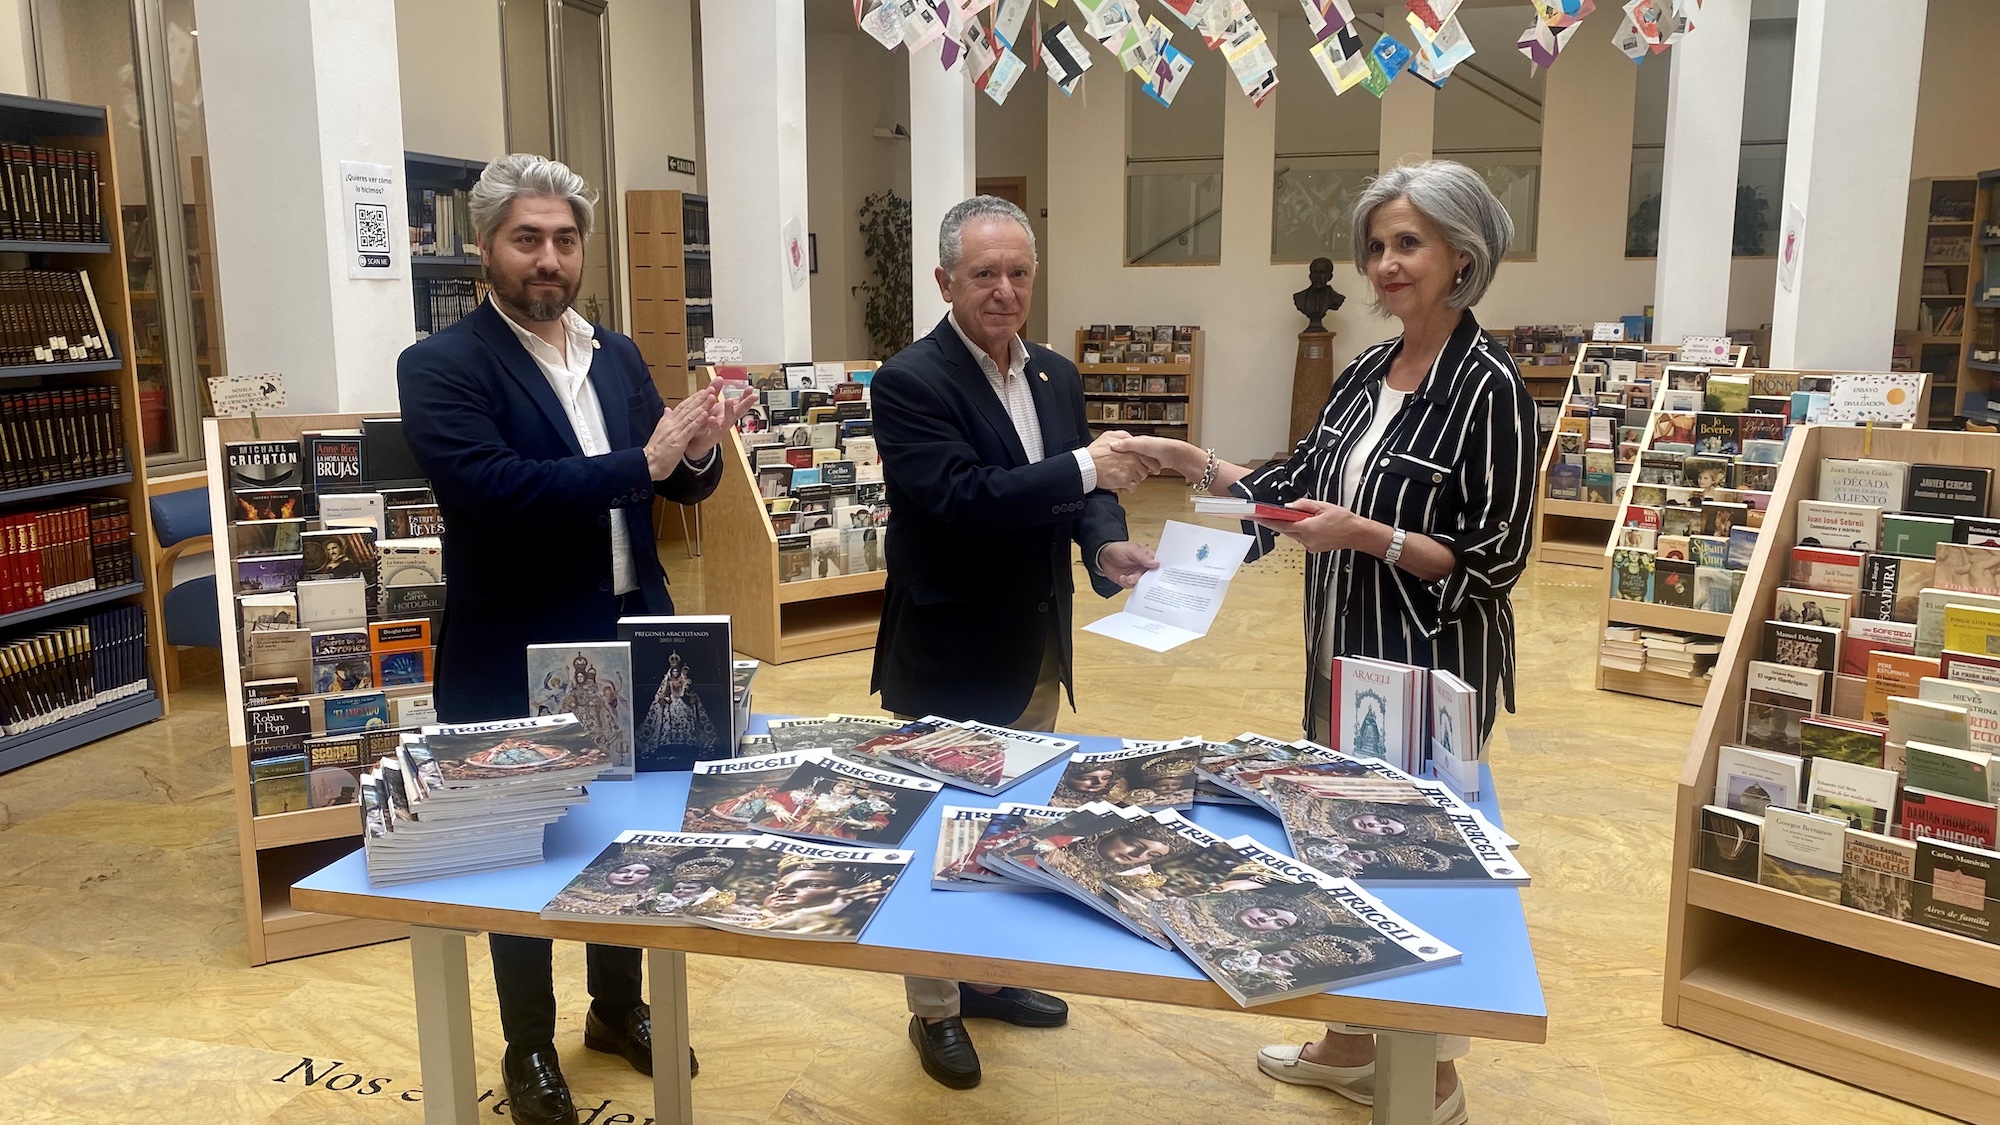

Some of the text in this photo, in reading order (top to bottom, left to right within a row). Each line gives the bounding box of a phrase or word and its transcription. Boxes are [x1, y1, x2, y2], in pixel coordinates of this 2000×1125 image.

[1758, 379, 1793, 391] MONK
[1713, 417, 1720, 426] Jo
[1700, 425, 1734, 436] Beverley
[239, 444, 286, 453] MICHAEL
[316, 444, 357, 455] Anne Rice
[230, 453, 297, 466] CRICHTON
[317, 462, 359, 478] BRUJAS
[1872, 468, 1893, 477] Galán
[1843, 476, 1890, 489] DÉCADA
[1920, 478, 1973, 491] JAVIER CERCAS
[1834, 493, 1887, 505] ALIENTO
[1807, 515, 1864, 527] Juan José Sebreli
[410, 523, 446, 536] REYES
[1968, 526, 1997, 535] Remedios
[1692, 539, 1723, 554] Susan
[1700, 553, 1723, 566] King
[1879, 564, 1896, 621] SCADURA
[1776, 630, 1822, 644] Manuel Delgado
[1352, 669, 1390, 685] ARACELI
[1961, 671, 1980, 679] razón
[1953, 694, 1982, 704] NIEVES
[253, 712, 284, 722] Robin
[1970, 707, 1998, 716] STRINA
[838, 716, 904, 729] ARACE
[1970, 718, 1998, 730] RITO
[253, 723, 290, 736] T. Popp
[970, 724, 1044, 744] ARACELI
[254, 734, 269, 745] La
[1971, 729, 2000, 744] ECTO
[311, 745, 358, 761] SCORPIO
[1082, 743, 1170, 763] ARACELI
[706, 755, 798, 775] ARACELI
[814, 757, 907, 786] ARACELI
[1776, 818, 1832, 836] Georges Bernanos
[1907, 807, 1990, 834] DAMIAN THOMPSON
[1162, 817, 1220, 847] ARAC
[1449, 814, 1506, 863] ARACELI
[629, 834, 732, 846] ARACELI
[767, 840, 871, 860] ARACELI
[1846, 843, 1910, 866] Las tertulias
[1845, 851, 1909, 874] de Madrid
[1931, 850, 1990, 869] Carlos Monsiváis
[1326, 884, 1420, 942] ARACELI
[1924, 905, 1990, 927] Aires de familia
[272, 1058, 393, 1096] Nos
